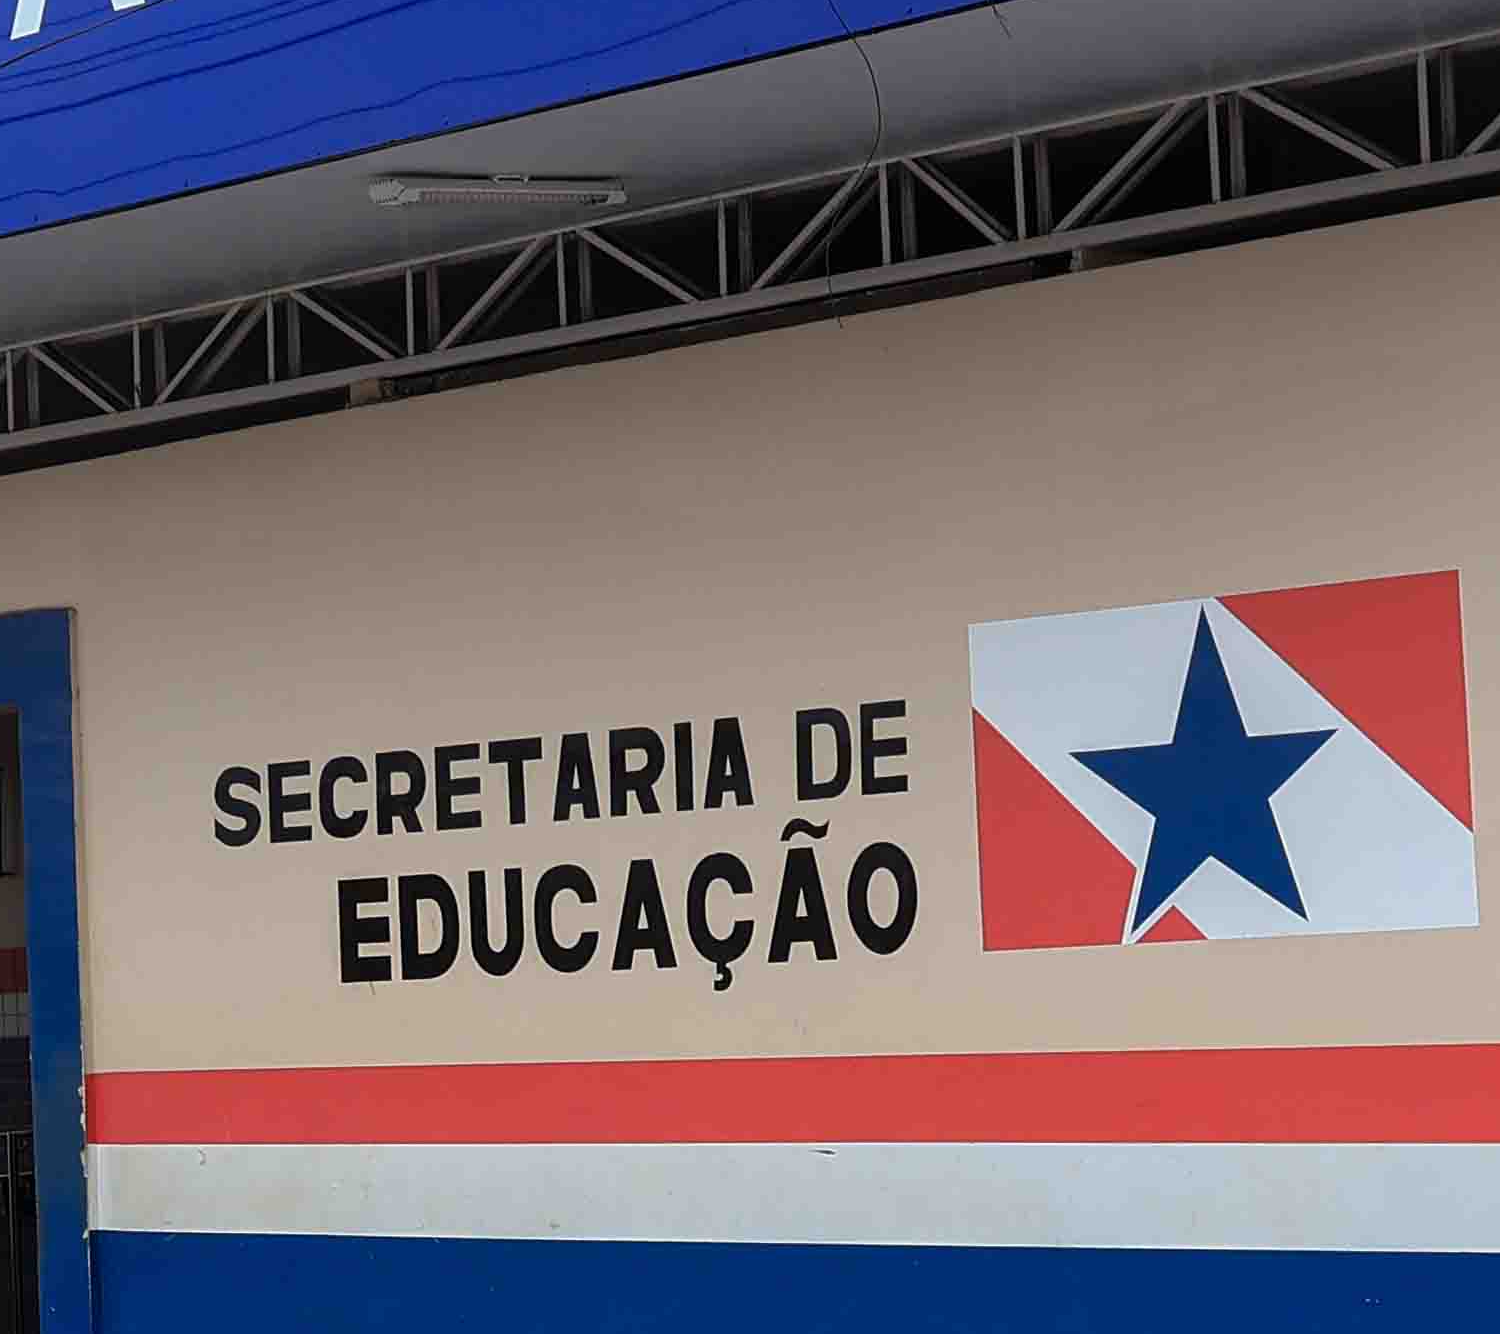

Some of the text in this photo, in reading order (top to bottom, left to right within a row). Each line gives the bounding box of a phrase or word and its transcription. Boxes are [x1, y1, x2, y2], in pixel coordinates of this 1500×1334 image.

[213, 698, 911, 848] SECRETARIA DE
[336, 817, 920, 993] EDUCAÇÃO
